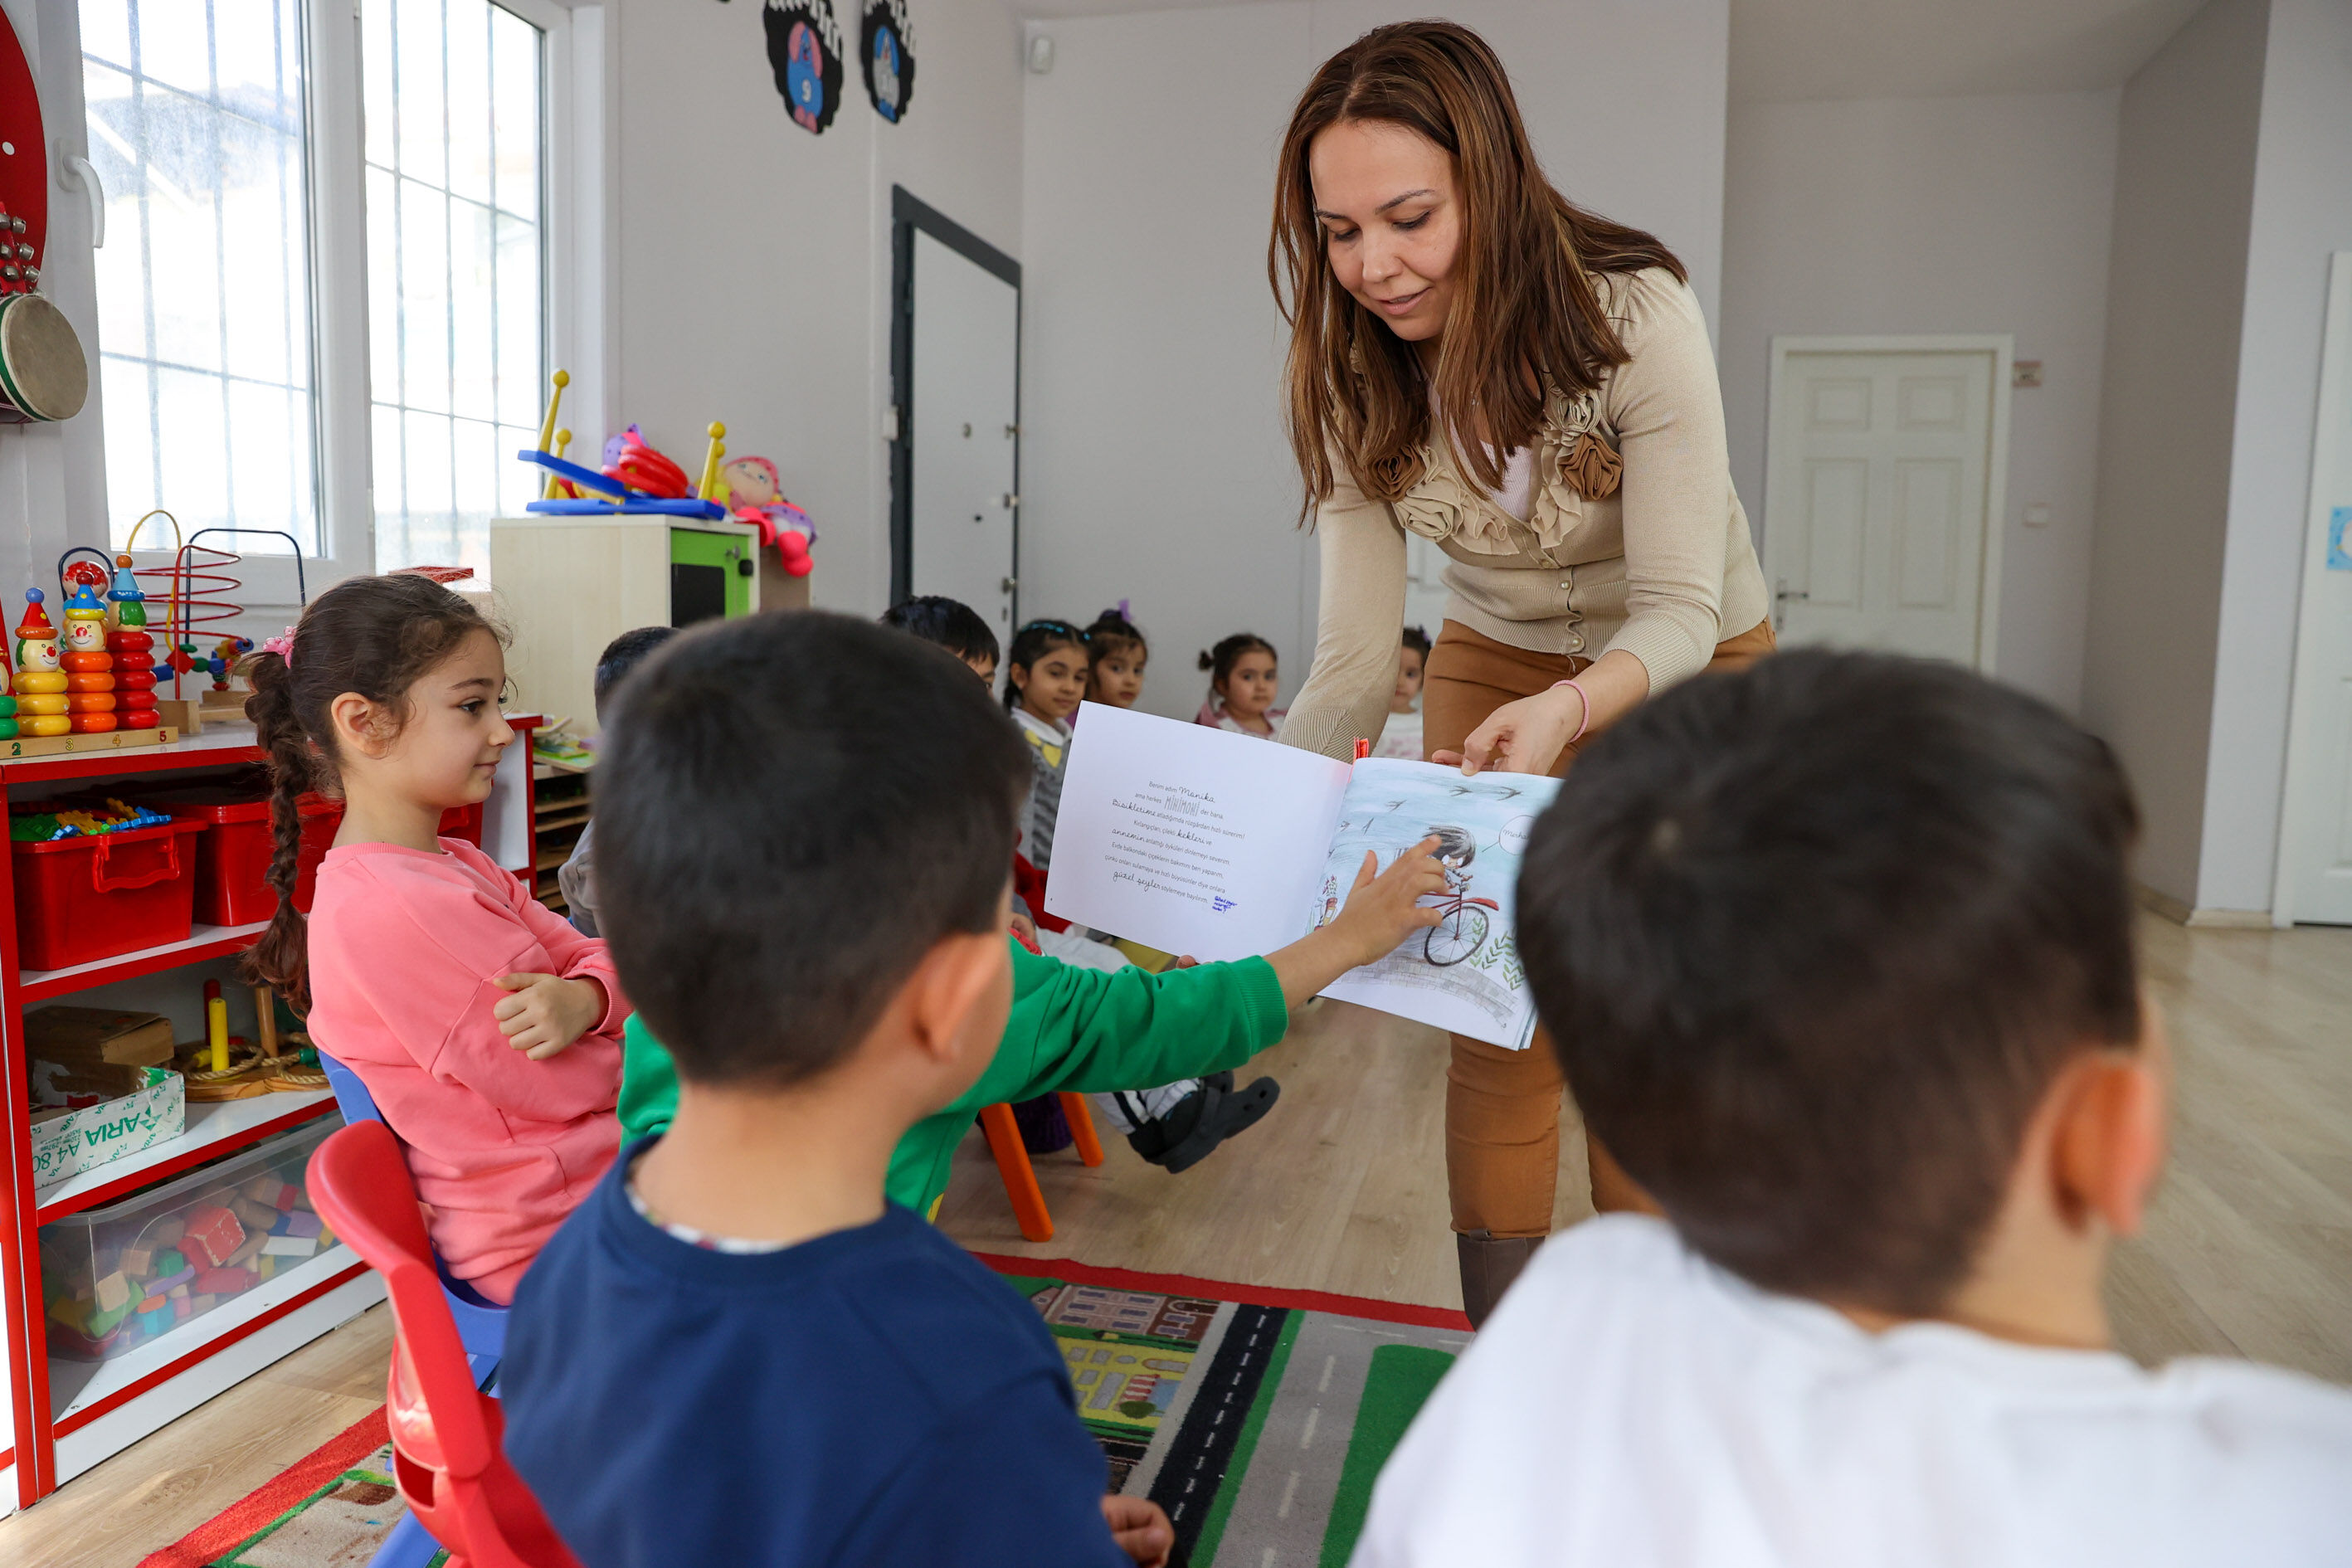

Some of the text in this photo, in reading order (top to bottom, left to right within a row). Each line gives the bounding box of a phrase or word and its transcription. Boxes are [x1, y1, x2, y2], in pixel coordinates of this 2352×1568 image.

[12, 730, 167, 756] 2 3 4 5
[1147, 795, 1161, 803] herkes
[1149, 781, 1164, 791] Benim
[1179, 786, 1215, 803] Manika
[1112, 799, 1156, 816] Bisikletime
[1112, 828, 1145, 841] annemin
[1176, 830, 1205, 844] kekleri
[1502, 830, 1530, 840] Merha
[1191, 864, 1200, 873] ben
[1113, 871, 1134, 883] güzel
[1137, 877, 1160, 892] şeyler
[1210, 885, 1225, 894] onlara
[85, 1113, 141, 1147] ARIA
[56, 1142, 80, 1164] A4
